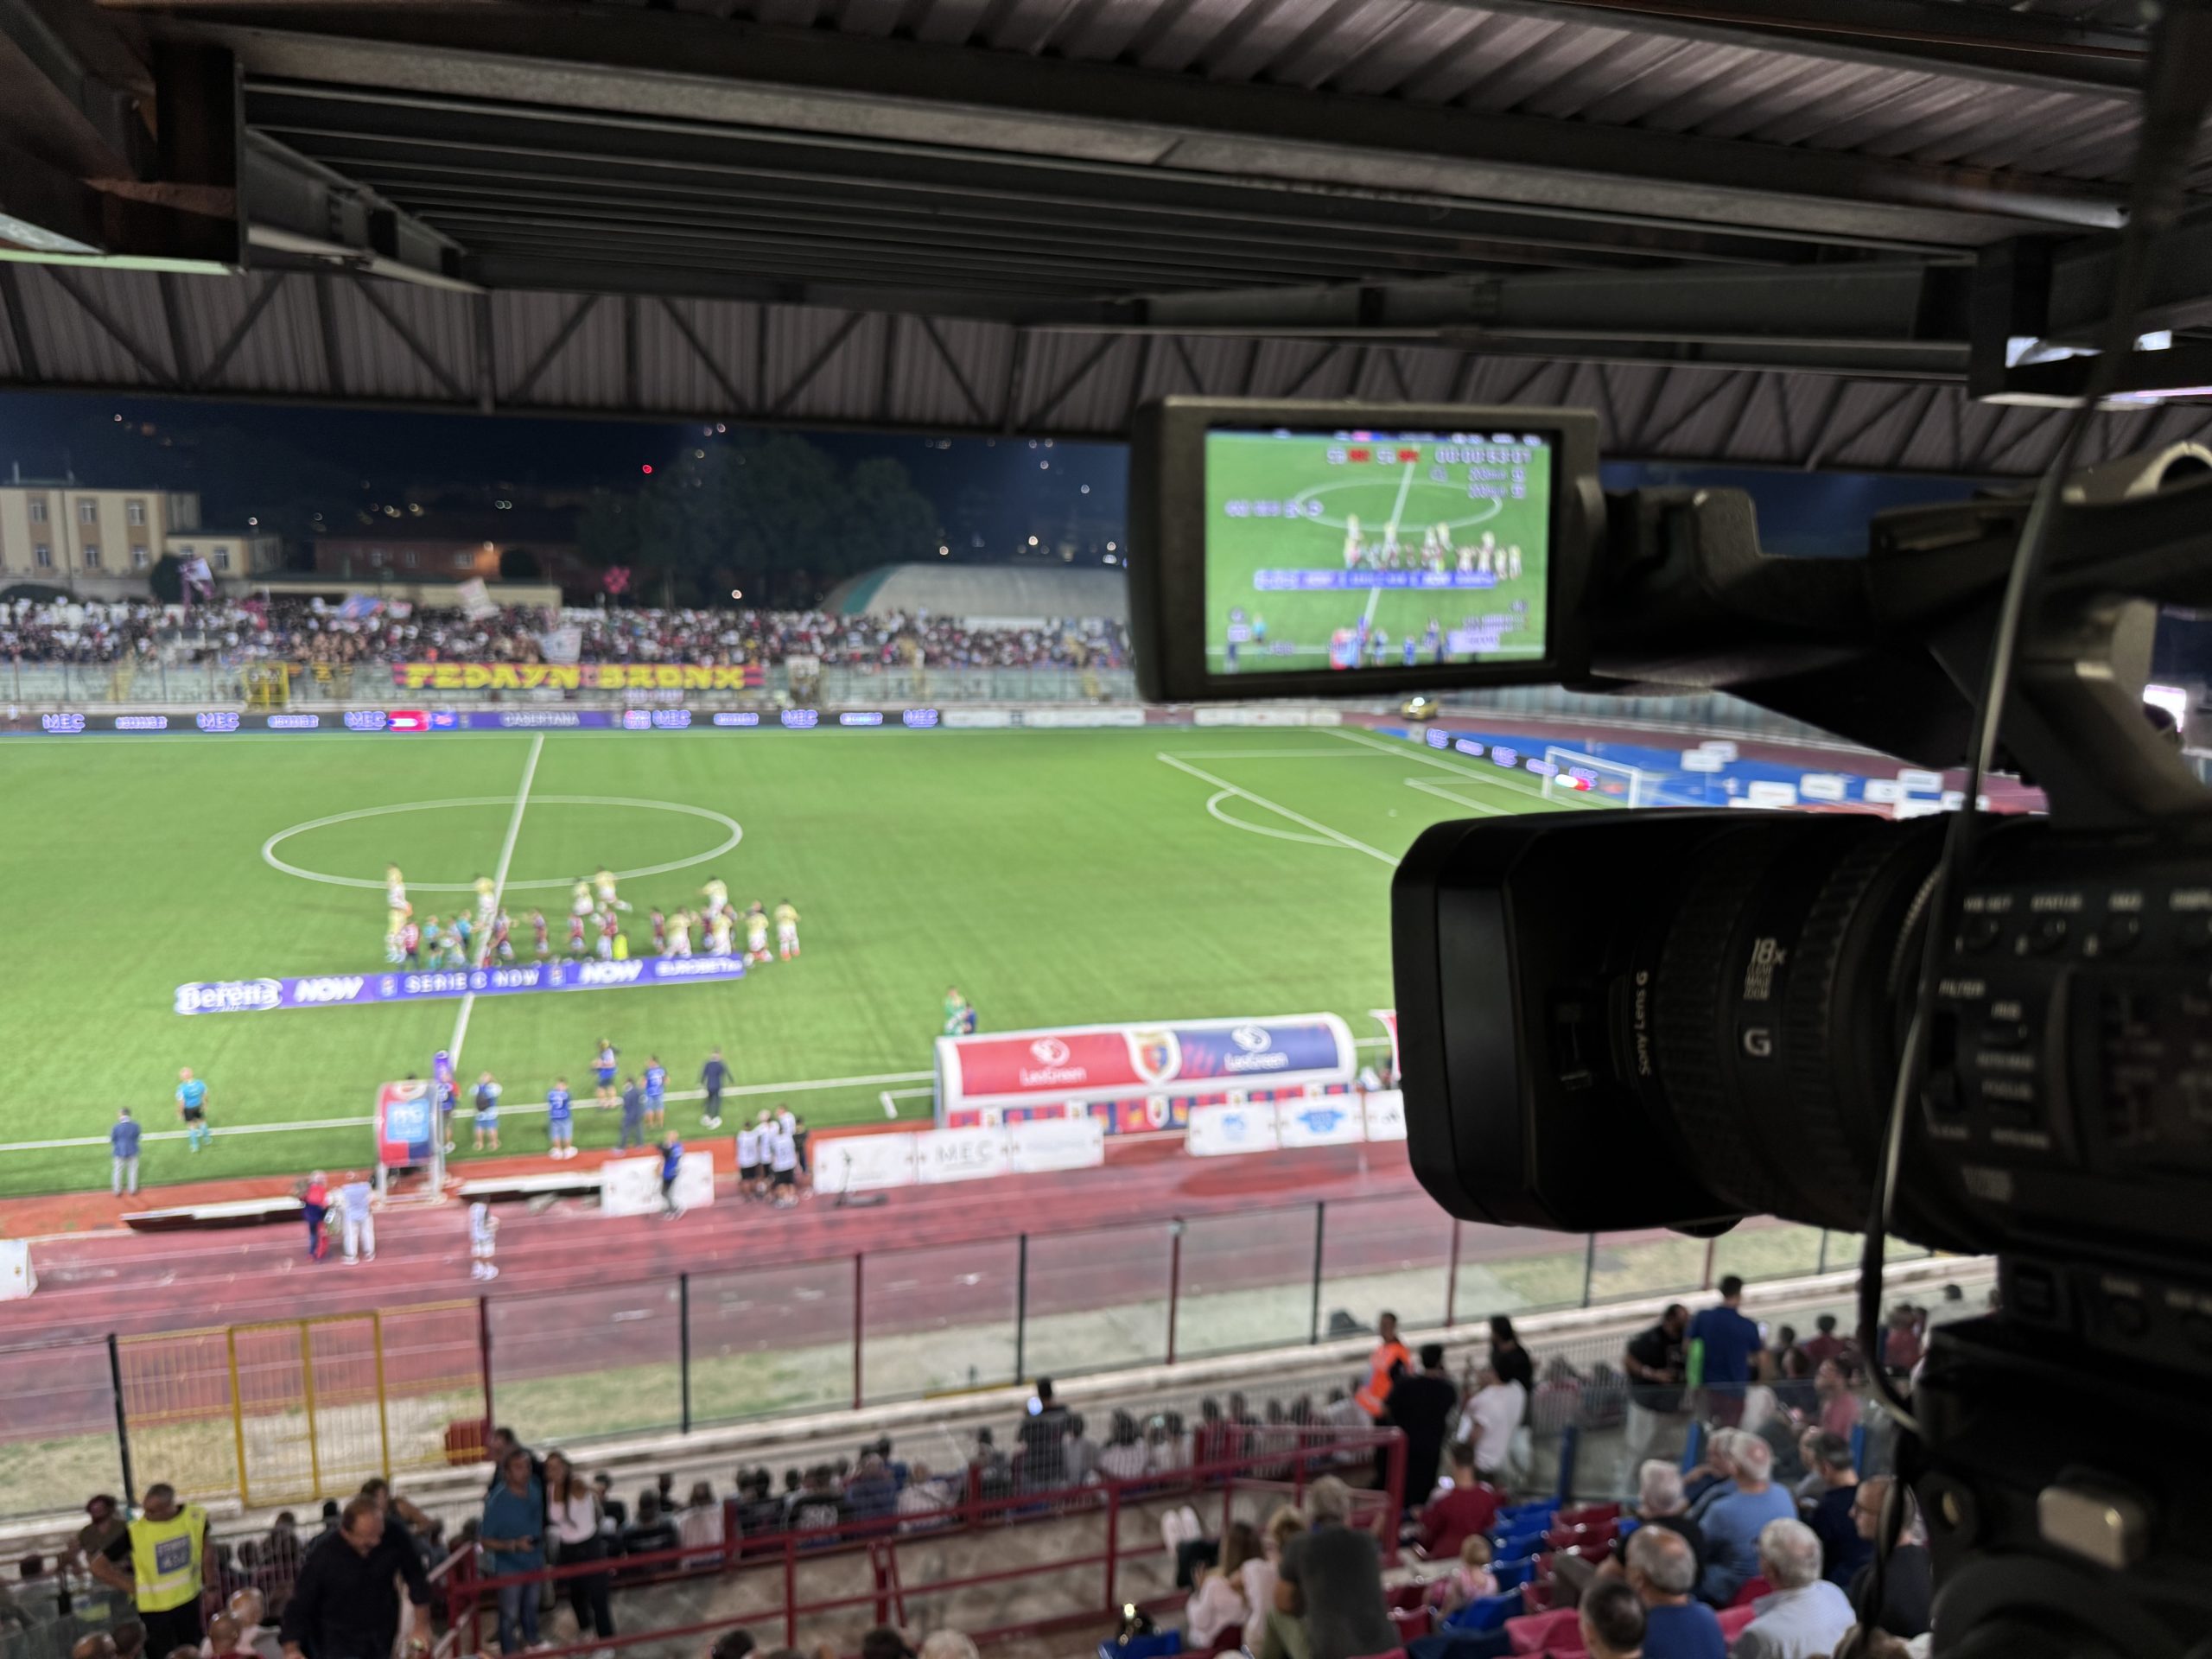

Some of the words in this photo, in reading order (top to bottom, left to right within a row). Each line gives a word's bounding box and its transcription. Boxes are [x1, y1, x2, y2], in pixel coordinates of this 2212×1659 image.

[406, 664, 581, 689] FEDAYN
[599, 664, 745, 689] BRONX
[1750, 938, 1788, 965] 18x
[404, 972, 467, 994] SERIE
[470, 971, 487, 990] C
[492, 969, 540, 988] NOW
[578, 959, 644, 984] NOW
[1635, 970, 1649, 987] G
[294, 976, 364, 1002] NOW
[1633, 988, 1646, 1030] Lens
[1635, 1032, 1653, 1077] Sony
[1743, 1027, 1771, 1057] G
[935, 1140, 995, 1162] MEC
